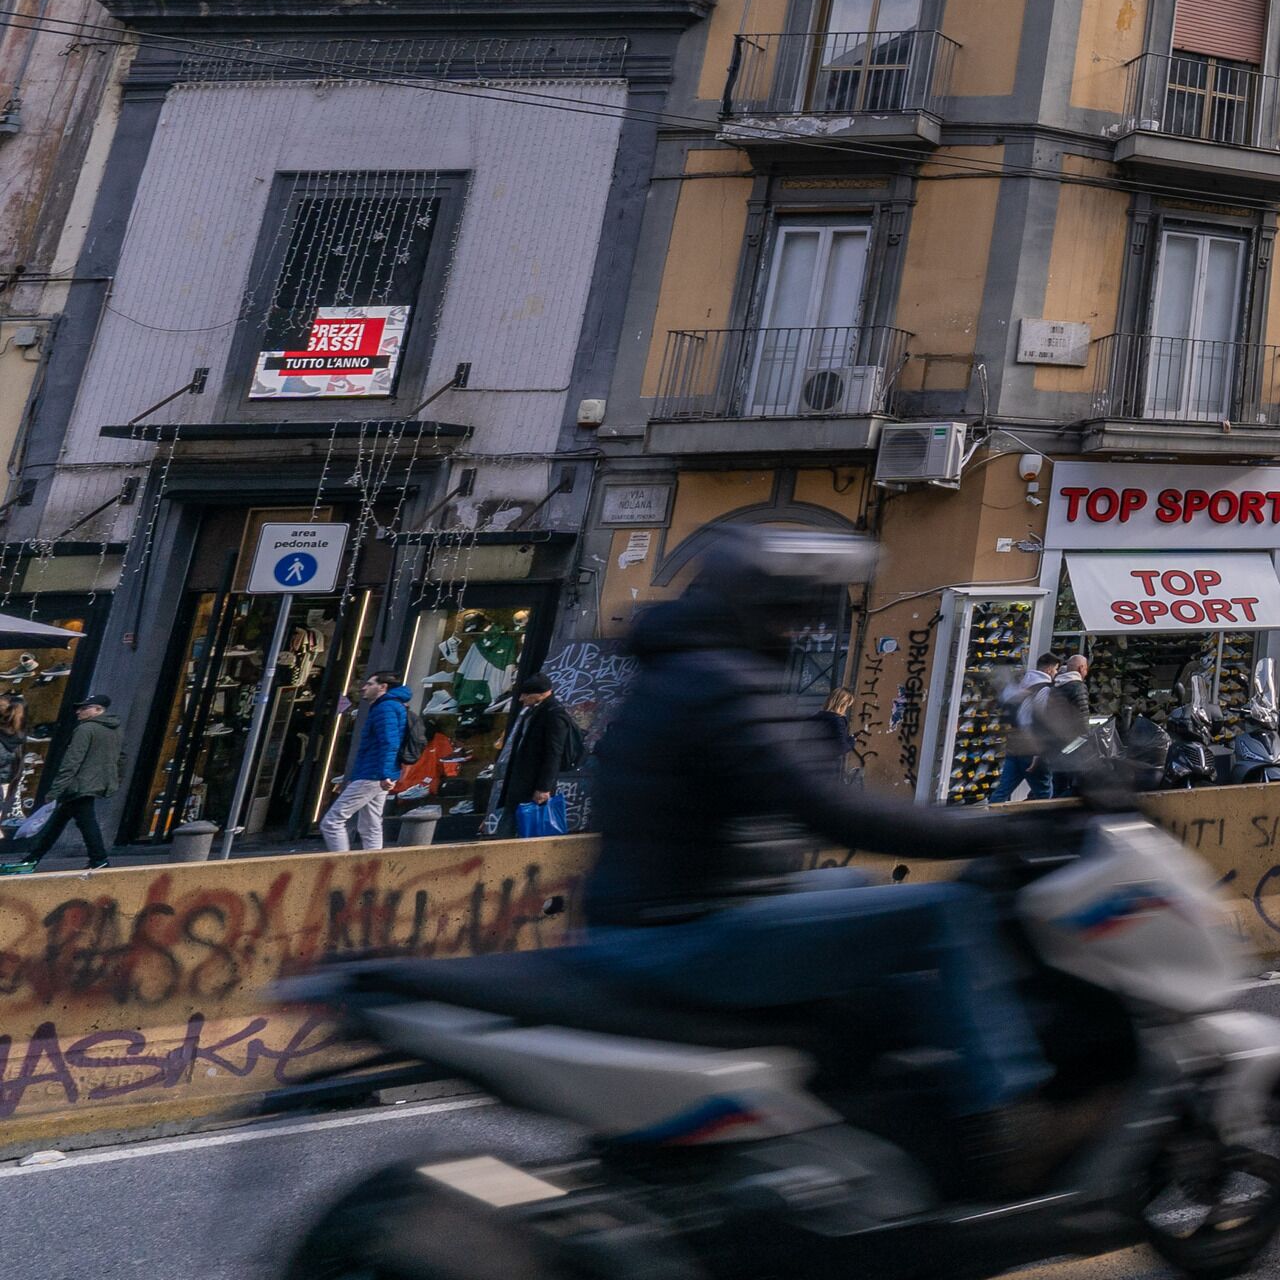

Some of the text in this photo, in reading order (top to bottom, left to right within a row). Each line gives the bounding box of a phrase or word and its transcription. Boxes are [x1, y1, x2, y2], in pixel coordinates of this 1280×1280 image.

[286, 356, 370, 369] TUTTO L'ANNO
[630, 489, 645, 499] VIA
[1059, 487, 1147, 523] TOP
[274, 539, 329, 549] pedonale
[1130, 570, 1222, 596] TOP
[1110, 598, 1260, 625] SPORT
[1251, 815, 1278, 848] SI
